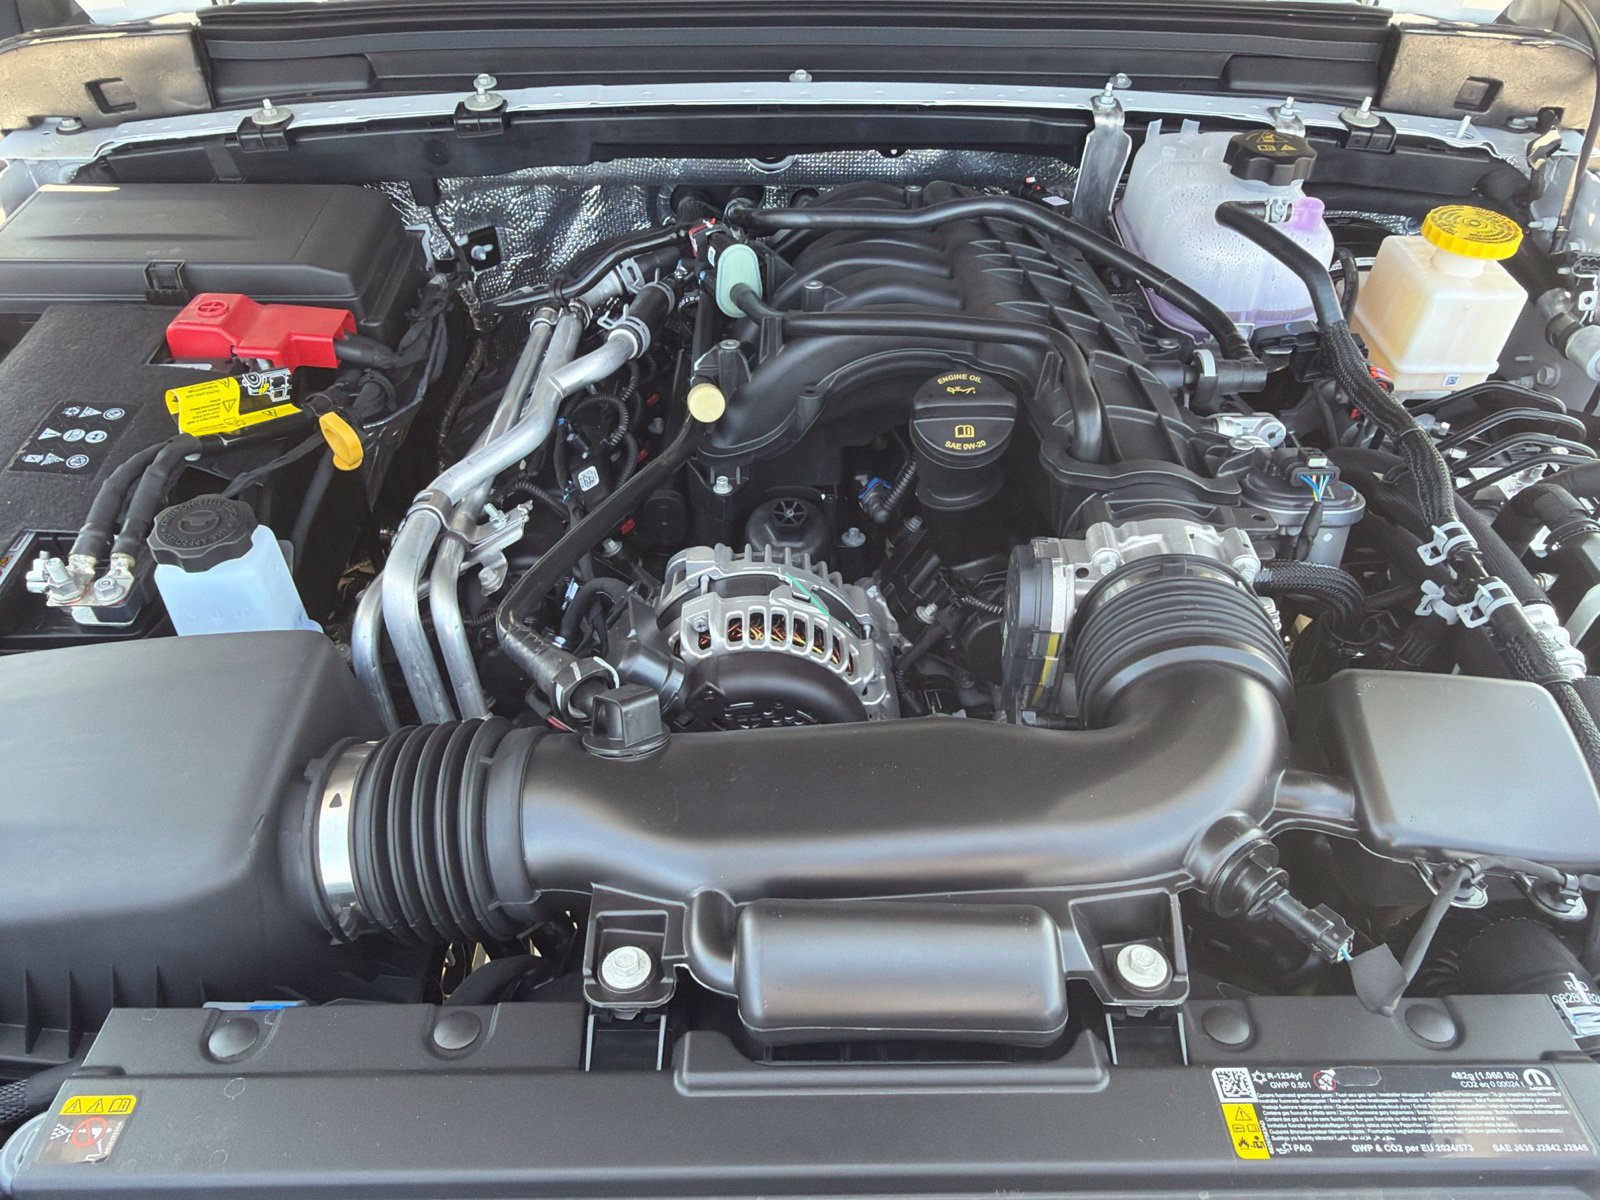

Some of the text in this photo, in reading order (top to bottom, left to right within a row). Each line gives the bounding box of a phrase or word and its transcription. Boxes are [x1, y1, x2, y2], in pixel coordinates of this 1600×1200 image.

[937, 373, 982, 385] ENGINE OIL
[944, 439, 987, 450] SAE 0W-20
[1451, 1071, 1476, 1081] 482g
[1503, 1071, 1519, 1081] lb)
[1270, 1081, 1312, 1089] GWP 0.501
[1460, 1080, 1479, 1088] CO2
[1293, 1143, 1313, 1153] PAG
[1351, 1143, 1374, 1152] GWP
[1383, 1143, 1404, 1152] CO2
[1404, 1144, 1420, 1154] per
[1420, 1143, 1435, 1152] EU
[1492, 1143, 1513, 1152] SAE
